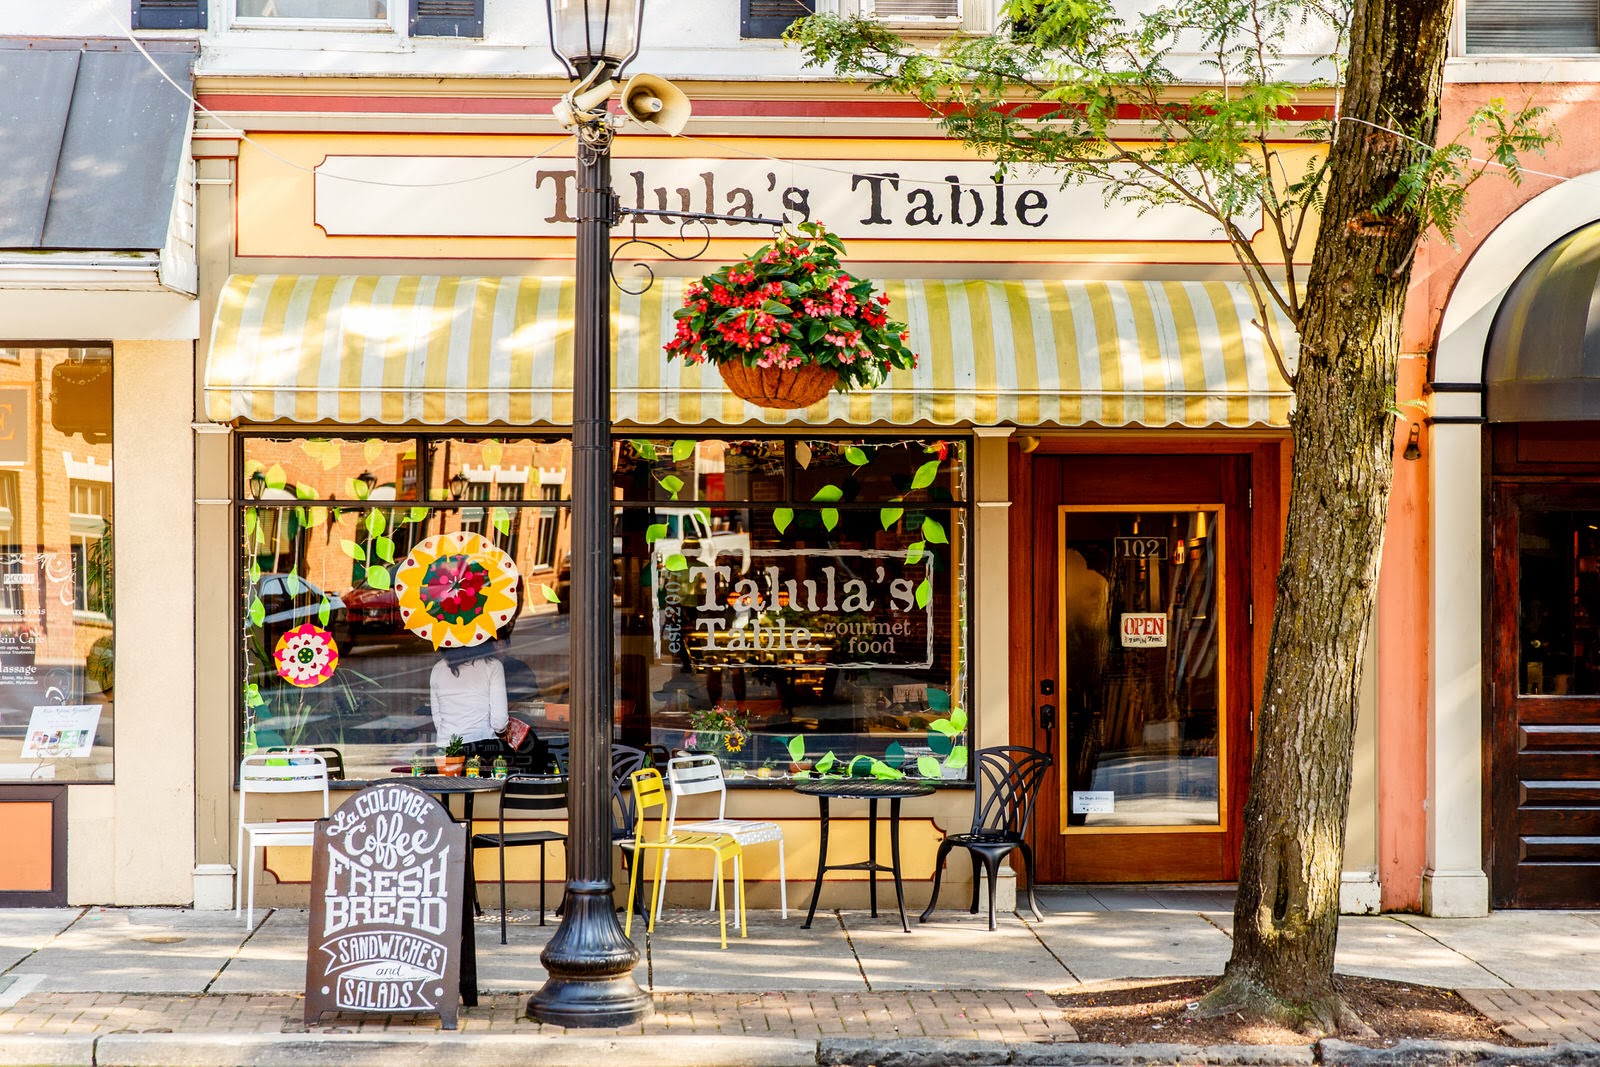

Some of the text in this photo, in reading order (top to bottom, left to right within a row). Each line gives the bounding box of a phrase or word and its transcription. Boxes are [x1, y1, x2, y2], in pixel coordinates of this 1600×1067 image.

[536, 170, 1049, 228] Tlula's Table
[1123, 540, 1160, 557] 102
[689, 566, 915, 612] Talula's
[19, 632, 45, 644] Care
[695, 618, 821, 651] Table.
[824, 619, 911, 637] gourmet
[1124, 618, 1164, 635] OPEN
[847, 637, 896, 654] food
[326, 789, 434, 836] La COLOMBE
[344, 813, 443, 870] Coffee
[325, 843, 450, 897] FRESH
[323, 896, 447, 938] BREAD
[338, 933, 441, 971] SANDWICHES
[376, 966, 401, 976] and
[344, 979, 413, 1008] SALADS
